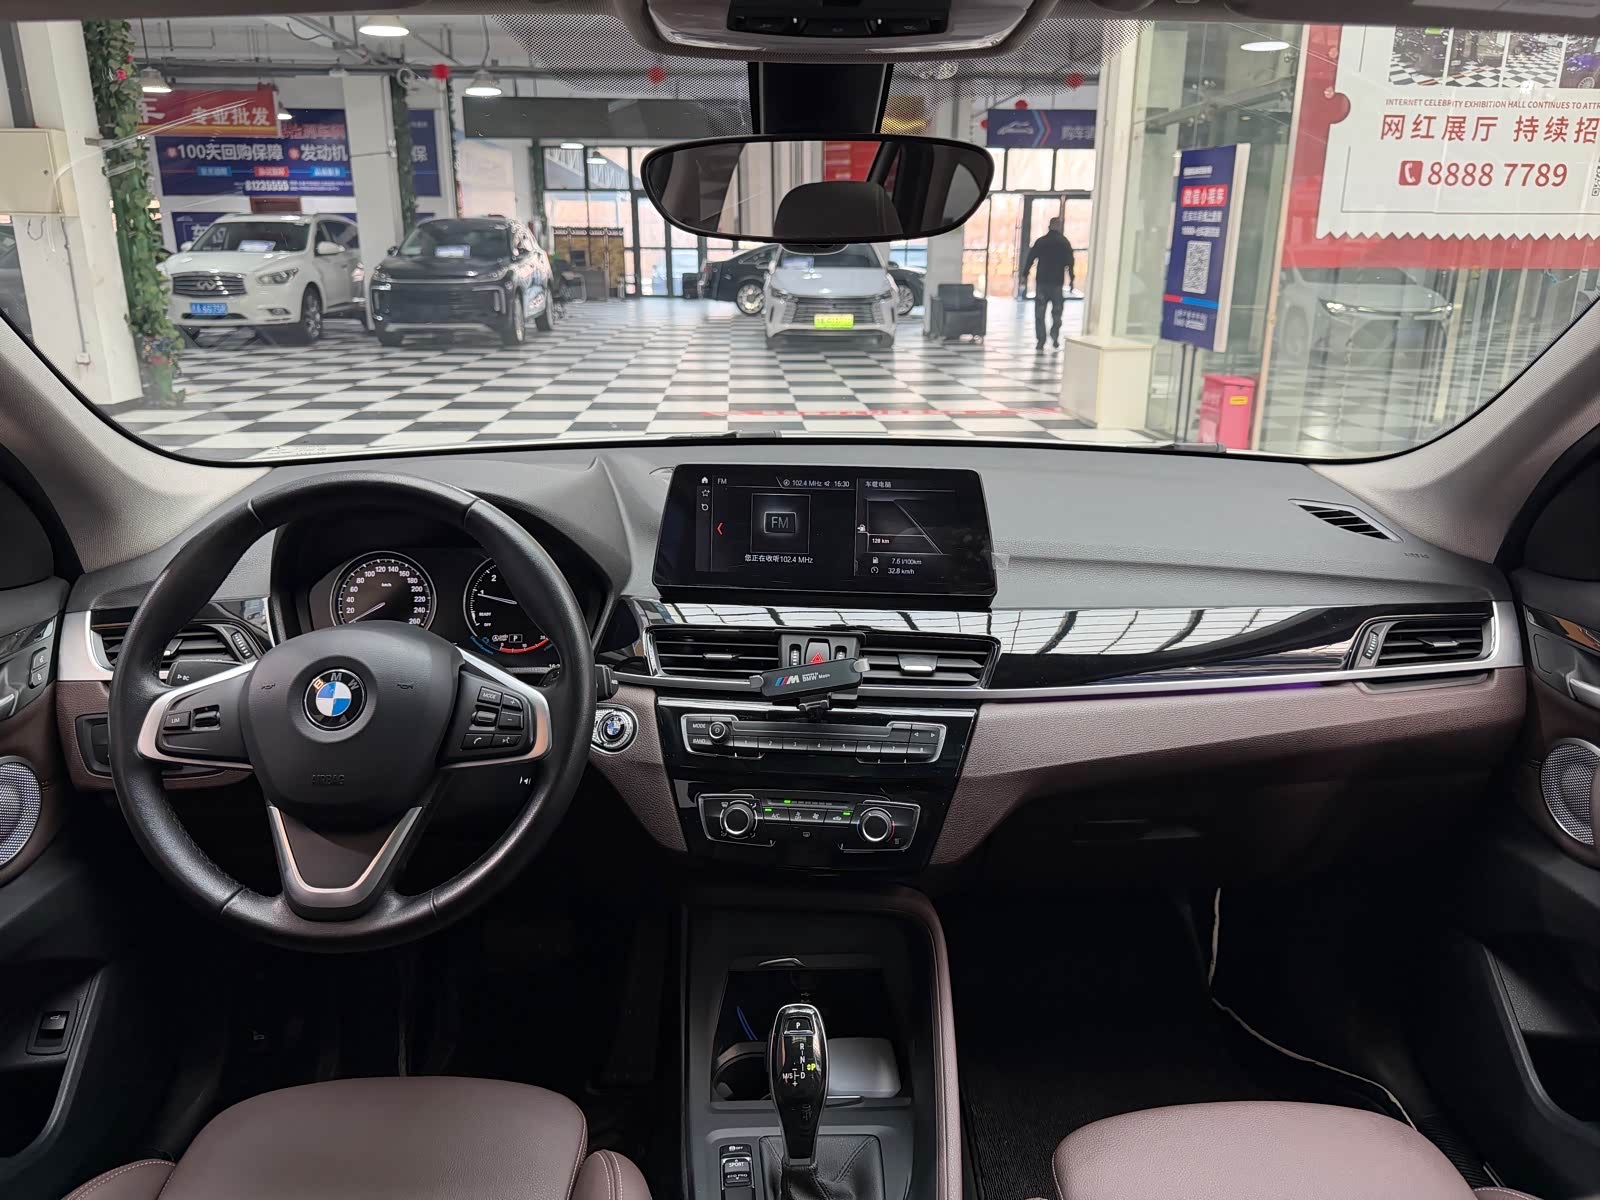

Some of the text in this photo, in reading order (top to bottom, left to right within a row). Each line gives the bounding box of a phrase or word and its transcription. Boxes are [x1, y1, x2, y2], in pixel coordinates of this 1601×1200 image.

[1424, 99, 1463, 108] CELEBRITY
[1464, 100, 1506, 108] EXHIBITION
[1527, 101, 1570, 109] CONTINUES
[192, 106, 270, 126] 专业批发
[1380, 114, 1600, 144] 网红展厅 持续招
[178, 144, 348, 161] 100天回购保障 发动机
[1427, 161, 1568, 187] 8888 7789
[770, 516, 789, 529] FM
[312, 671, 358, 691] BMW
[800, 1056, 805, 1064] N
